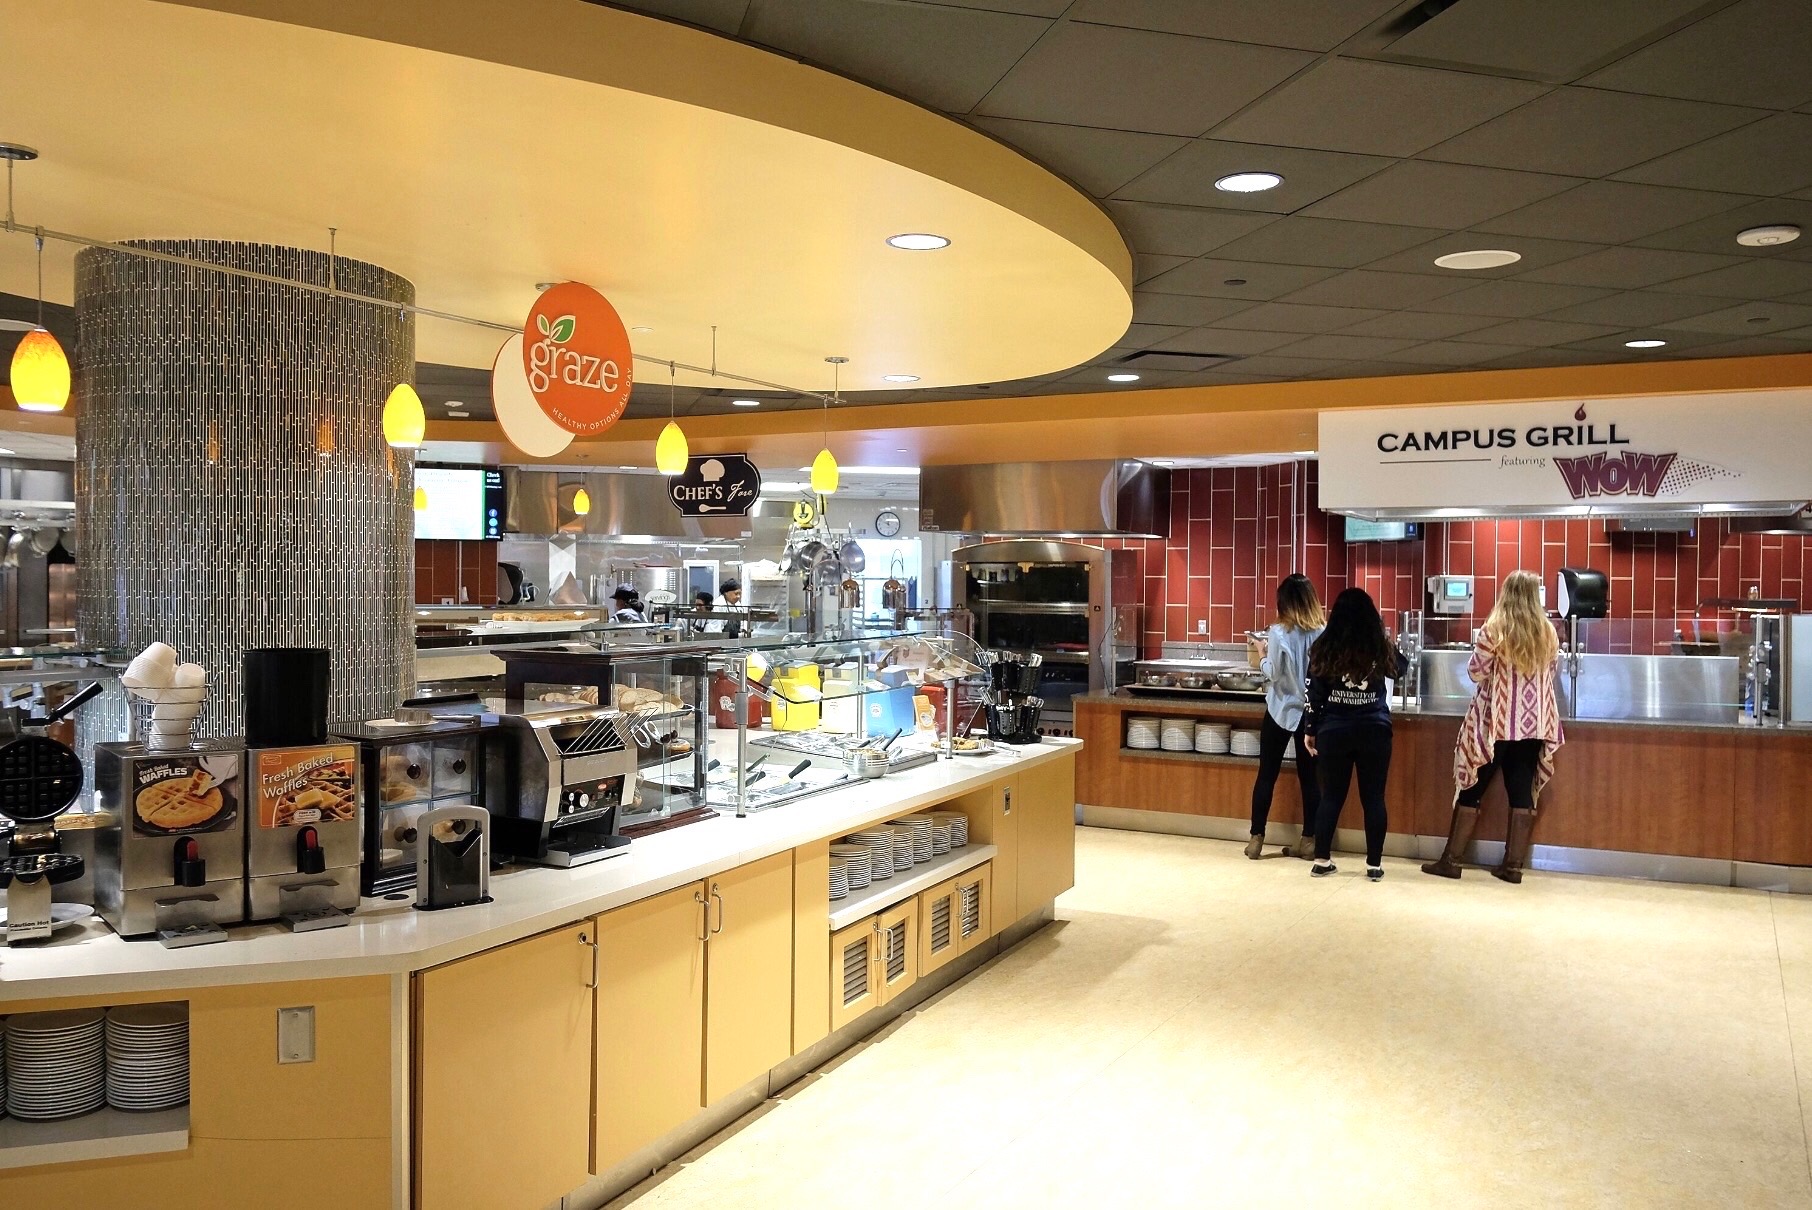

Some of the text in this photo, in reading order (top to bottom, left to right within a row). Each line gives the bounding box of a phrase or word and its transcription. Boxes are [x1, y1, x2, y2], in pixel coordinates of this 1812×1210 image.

[529, 338, 619, 393] graze
[552, 407, 587, 430] HEALTHY
[589, 408, 620, 430] OPTIONS
[619, 393, 628, 408] ALL
[1377, 424, 1630, 452] CAMPUS GRILL
[1499, 455, 1546, 469] featuring
[1553, 451, 1677, 500] WOW
[673, 479, 753, 502] CHEF'S Fare
[139, 768, 188, 784] WAFFLES
[262, 752, 333, 784] Fresh Baked
[263, 777, 308, 798] Waffles
